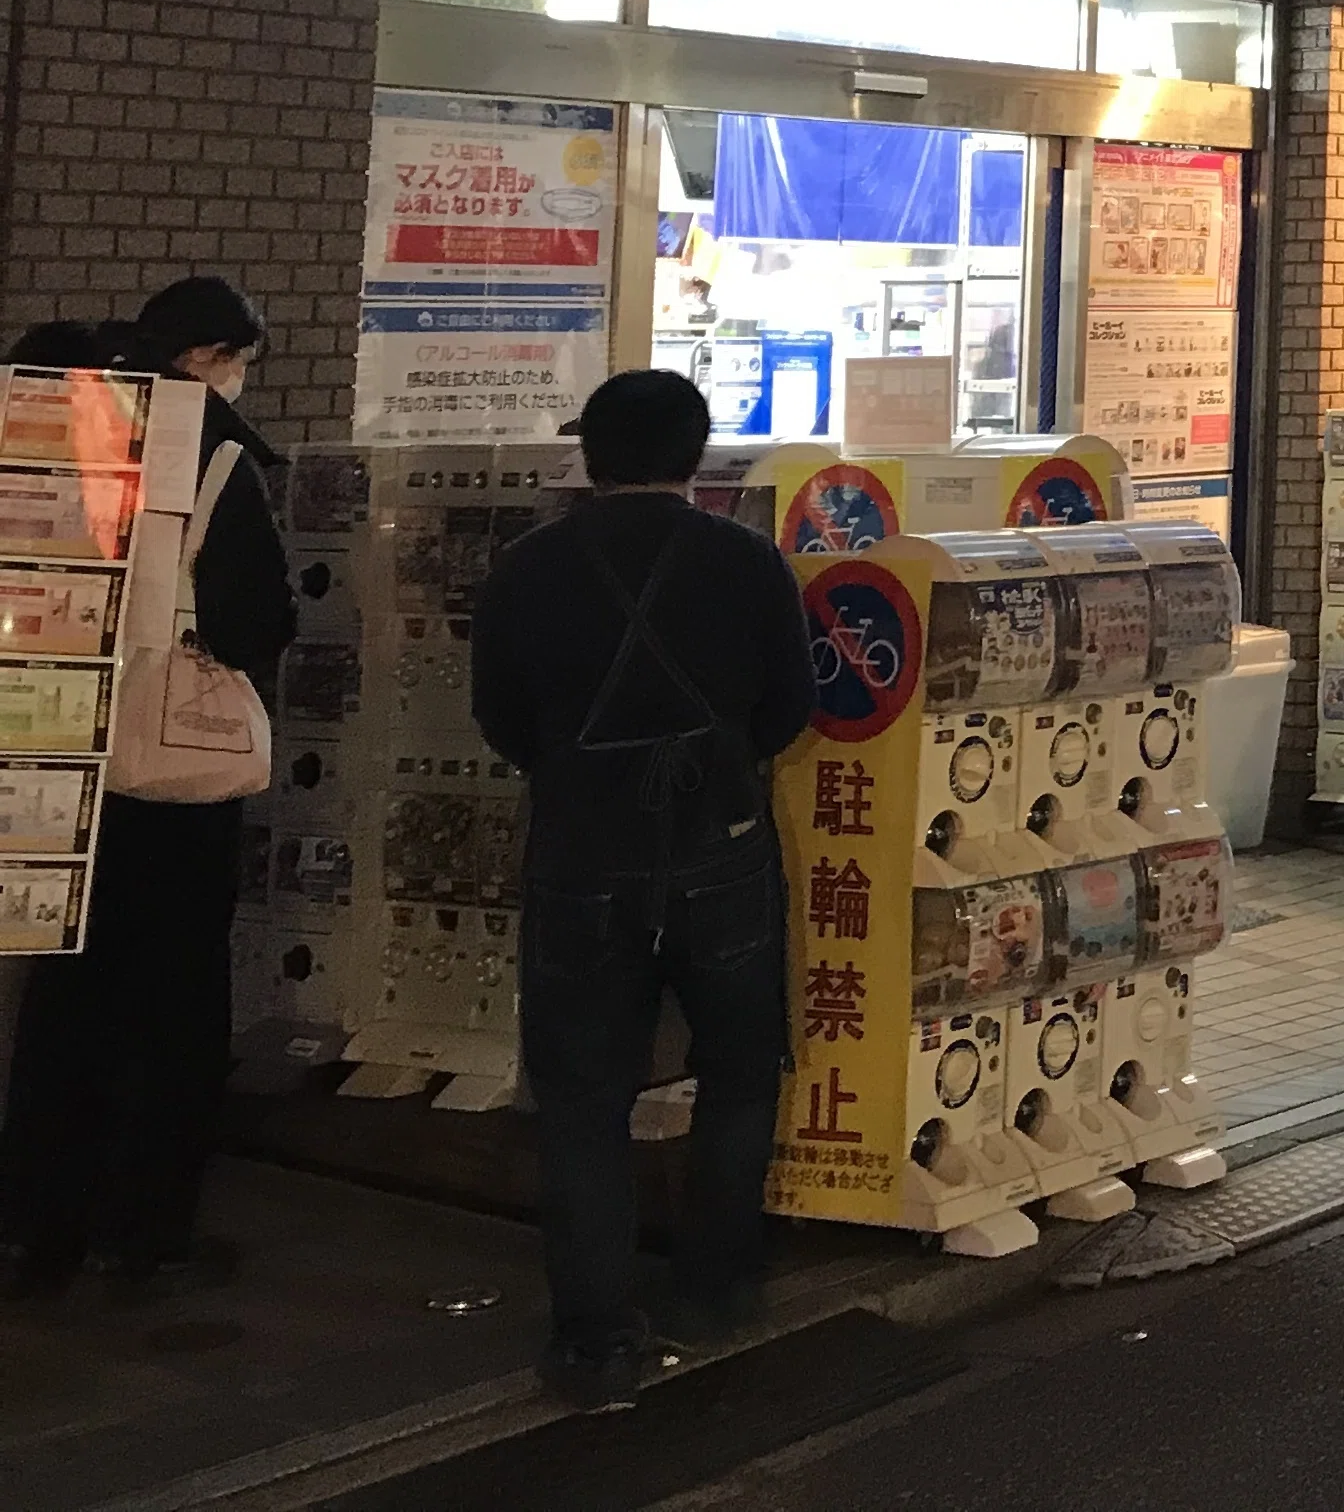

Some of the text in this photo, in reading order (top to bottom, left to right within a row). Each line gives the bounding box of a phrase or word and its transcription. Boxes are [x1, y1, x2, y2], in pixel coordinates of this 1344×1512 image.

[429, 141, 504, 162] ご入店には
[394, 162, 536, 195] マスク着用が
[393, 192, 530, 217] 必須となります。
[796, 759, 874, 1143] 駐輪禁止
